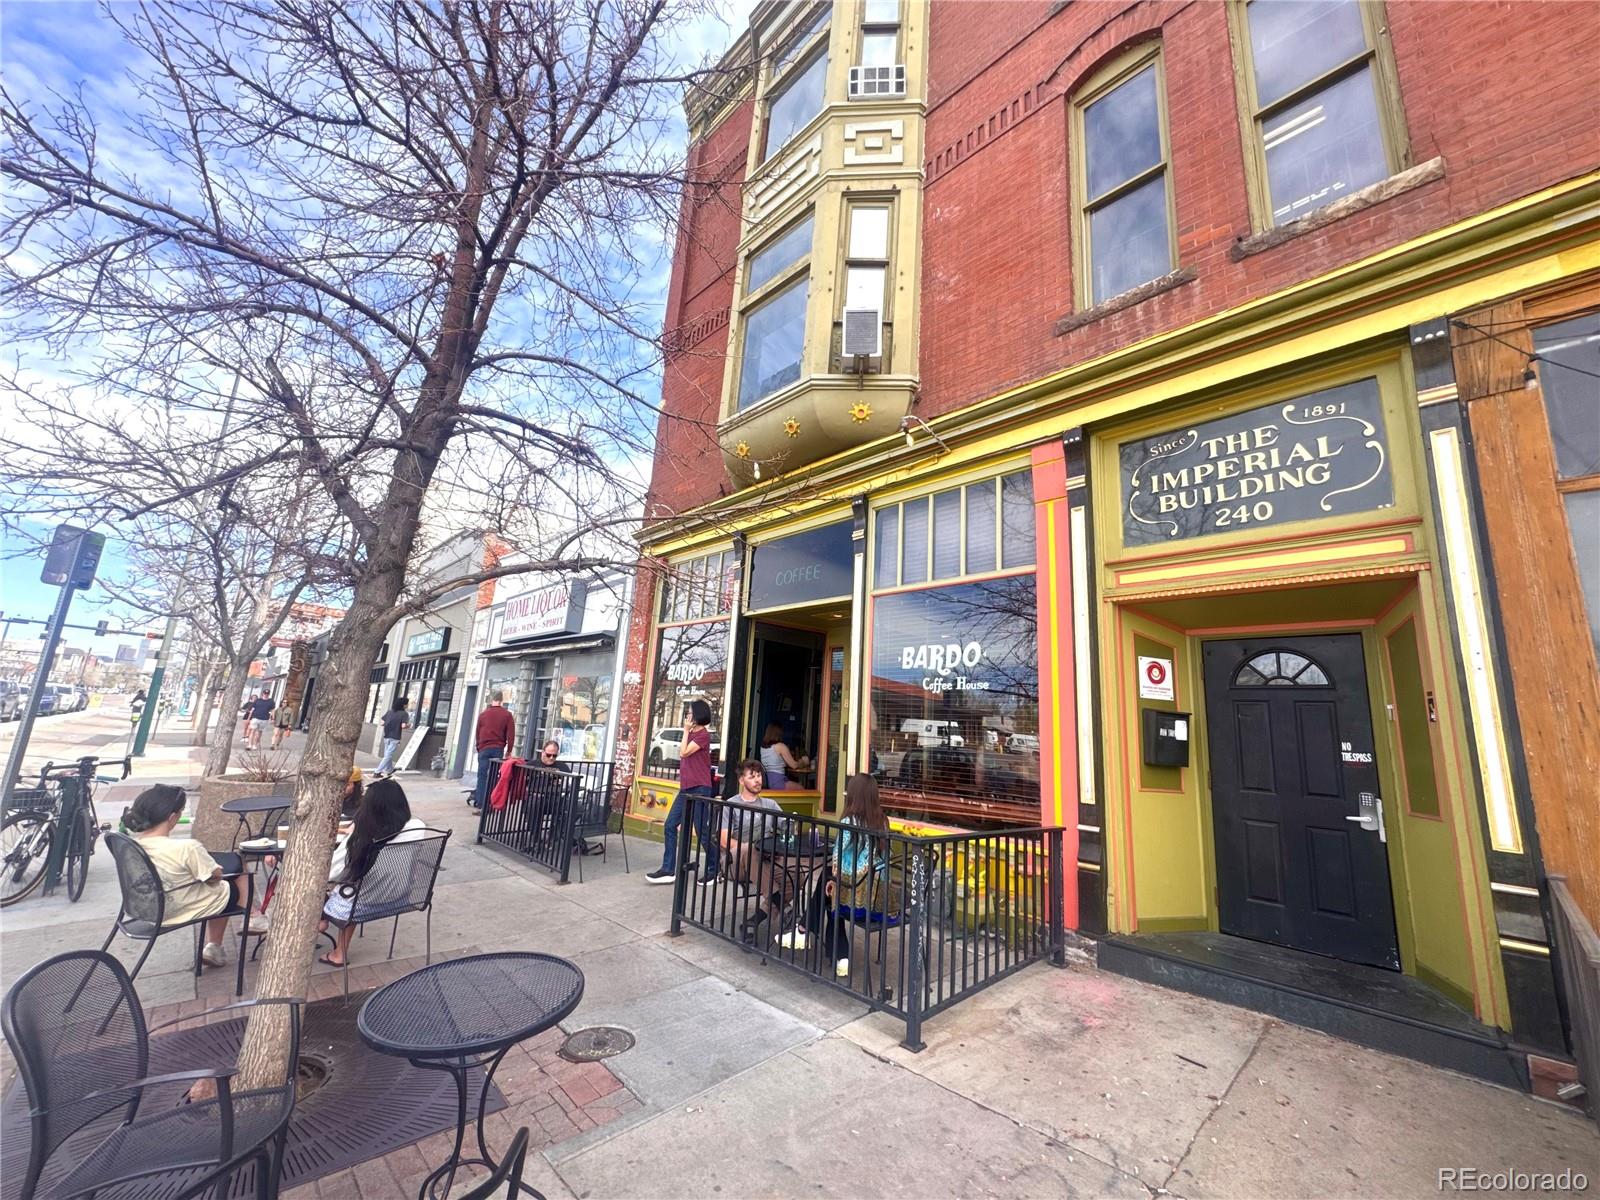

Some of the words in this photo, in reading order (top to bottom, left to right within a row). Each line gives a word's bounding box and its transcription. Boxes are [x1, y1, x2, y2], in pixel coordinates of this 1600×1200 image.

[1303, 402, 1345, 418] 1891
[1150, 437, 1186, 457] Since
[1200, 424, 1280, 459] THE
[1151, 435, 1343, 494] IMPERIAL
[1159, 462, 1331, 513] BUILDING
[1215, 501, 1274, 527] 240
[775, 564, 822, 586] COFFEE
[506, 597, 531, 620] HOME
[521, 622, 537, 631] WINE
[542, 617, 564, 628] SPIRIT
[902, 641, 982, 676] BARDO
[667, 662, 705, 685] BARDO
[922, 677, 952, 693] Coffee
[955, 676, 989, 690] House
[676, 686, 690, 697] Coffee
[1341, 741, 1352, 751] NO
[1341, 752, 1372, 762] TRESPASS
